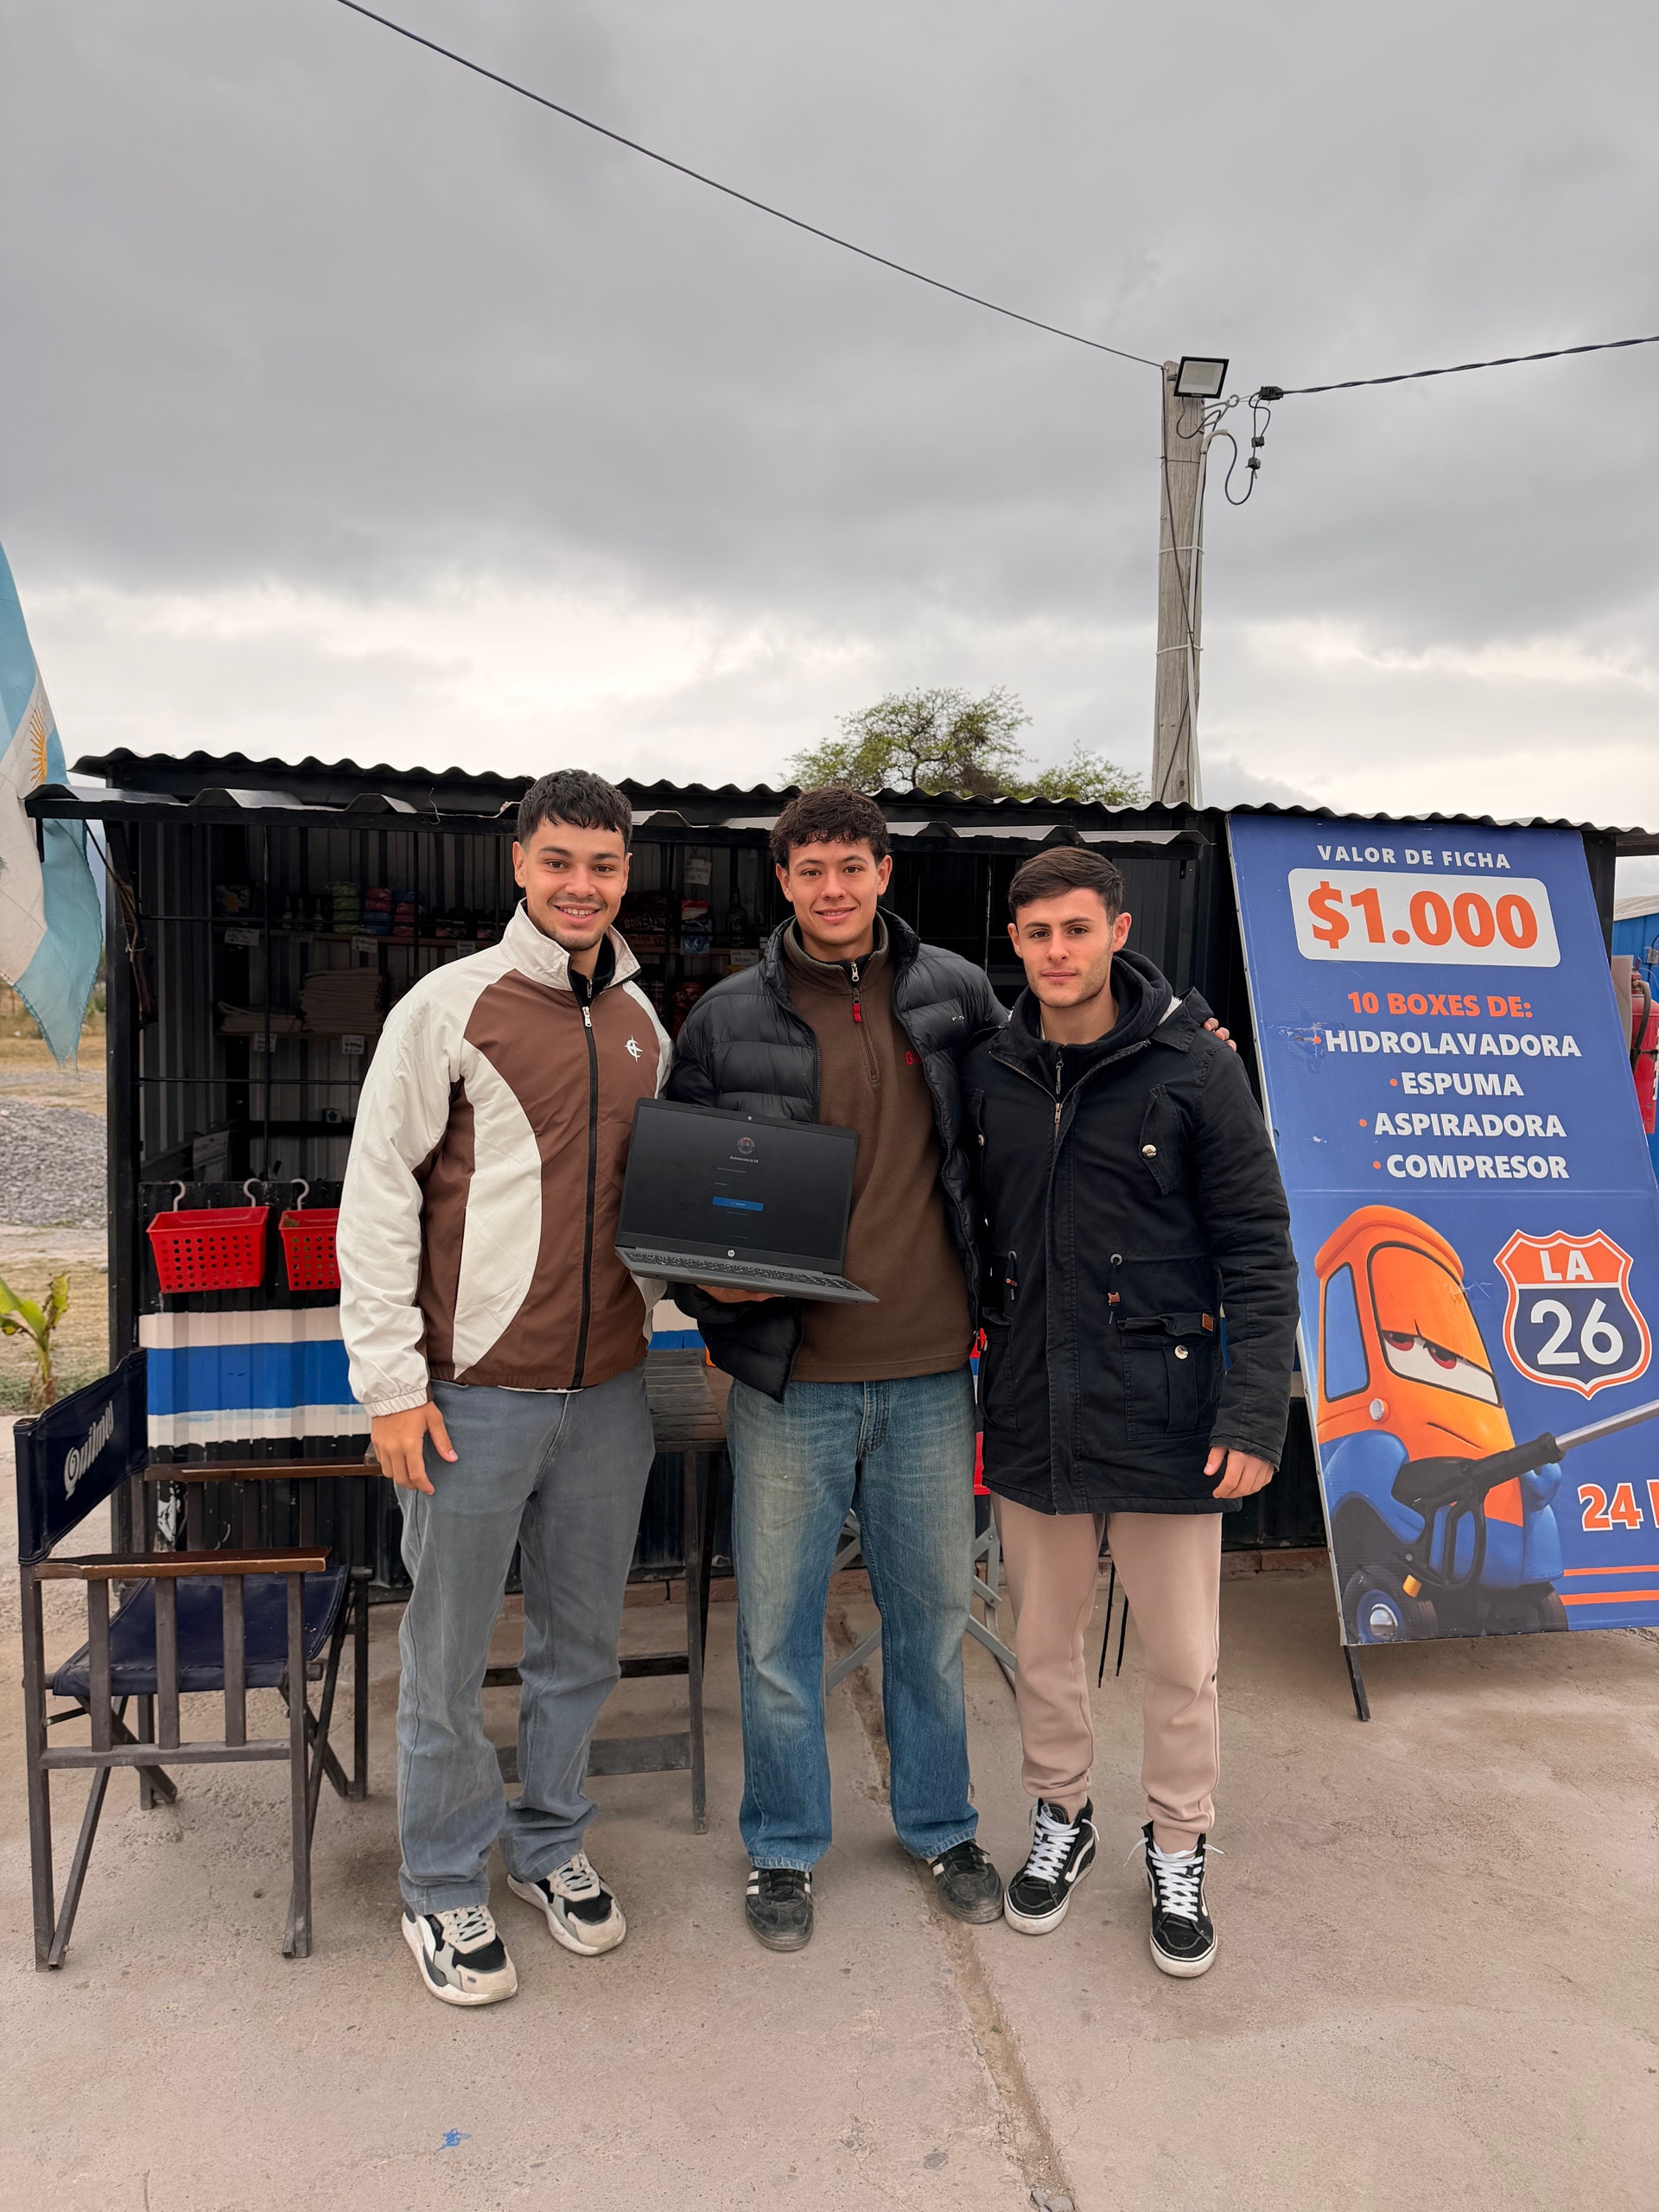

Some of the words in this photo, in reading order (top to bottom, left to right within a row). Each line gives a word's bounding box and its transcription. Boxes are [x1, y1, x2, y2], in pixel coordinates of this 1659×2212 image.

[1317, 845, 1396, 863] VALOR
[1404, 849, 1433, 865] DE
[1441, 851, 1511, 869] FICHA
[1307, 880, 1538, 949] $1.000
[1347, 991, 1379, 1014] 10
[1387, 993, 1480, 1016] BOXES
[1486, 995, 1533, 1018] DE:
[1325, 1029, 1582, 1058] HIDROLAVADORA
[1401, 1071, 1524, 1096] ESPUMA
[1374, 1112, 1567, 1137] ASPIRADORA
[1386, 1154, 1569, 1179] COMPRESOR
[1539, 1250, 1594, 1281] LA
[1530, 1298, 1624, 1366] 26
[1577, 1483, 1643, 1532] 24
